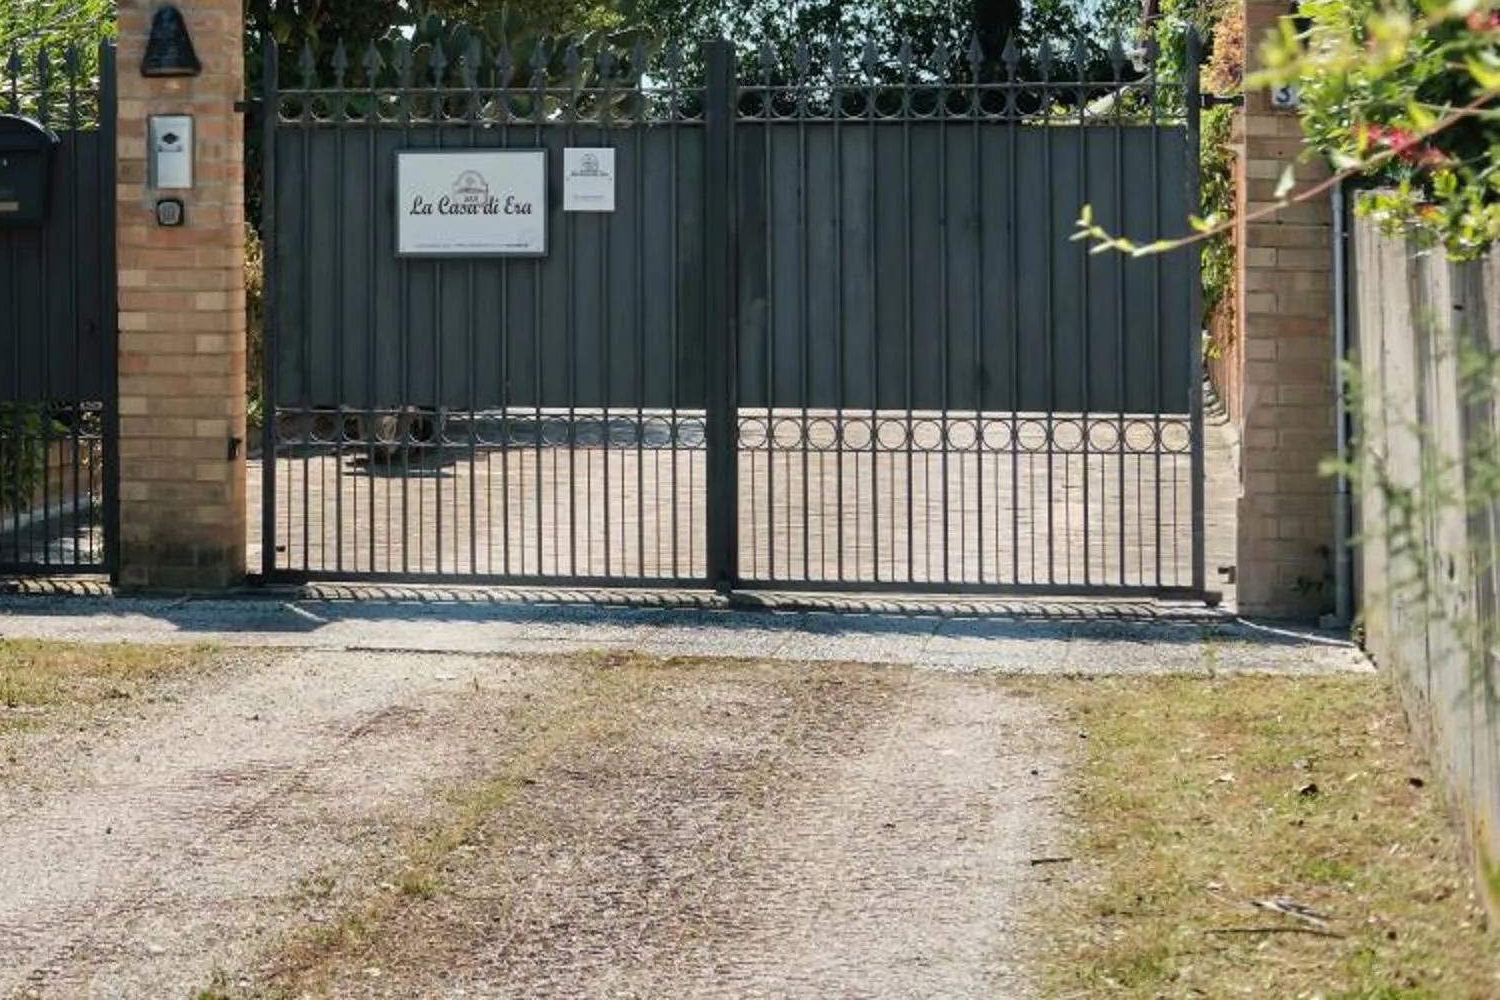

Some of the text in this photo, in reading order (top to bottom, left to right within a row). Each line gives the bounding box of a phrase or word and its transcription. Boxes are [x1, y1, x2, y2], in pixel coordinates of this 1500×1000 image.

[409, 195, 433, 215] La
[438, 195, 478, 215] Casa
[483, 196, 500, 215] di
